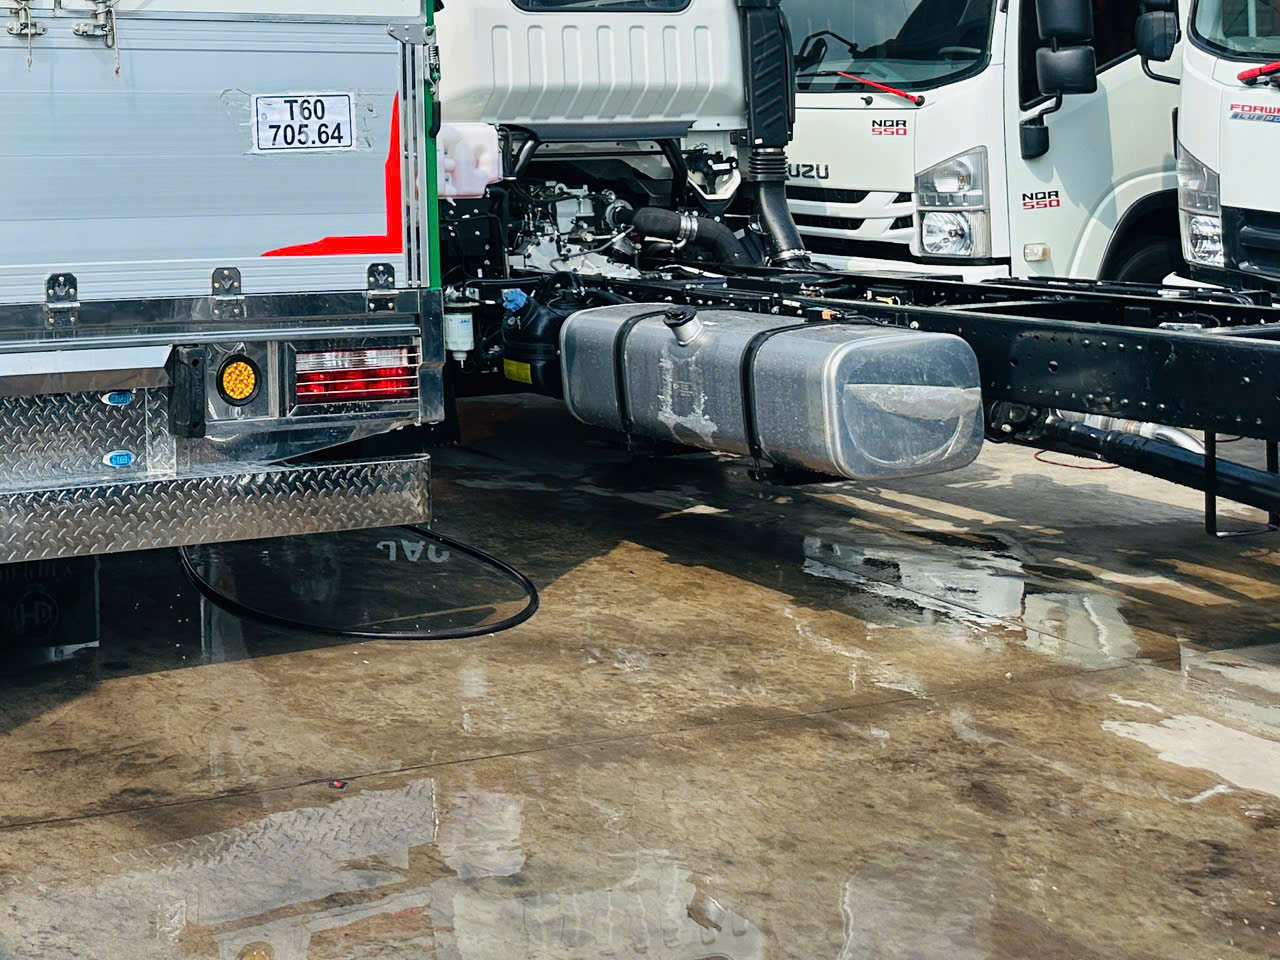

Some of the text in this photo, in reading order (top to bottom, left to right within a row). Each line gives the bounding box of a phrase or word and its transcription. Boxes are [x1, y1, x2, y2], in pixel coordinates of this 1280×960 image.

[284, 99, 326, 121] T60
[269, 123, 344, 146] 705.64
[872, 128, 907, 136] 550
[787, 163, 829, 179] UZU
[1022, 190, 1059, 201] NQR
[1023, 199, 1061, 210] 550
